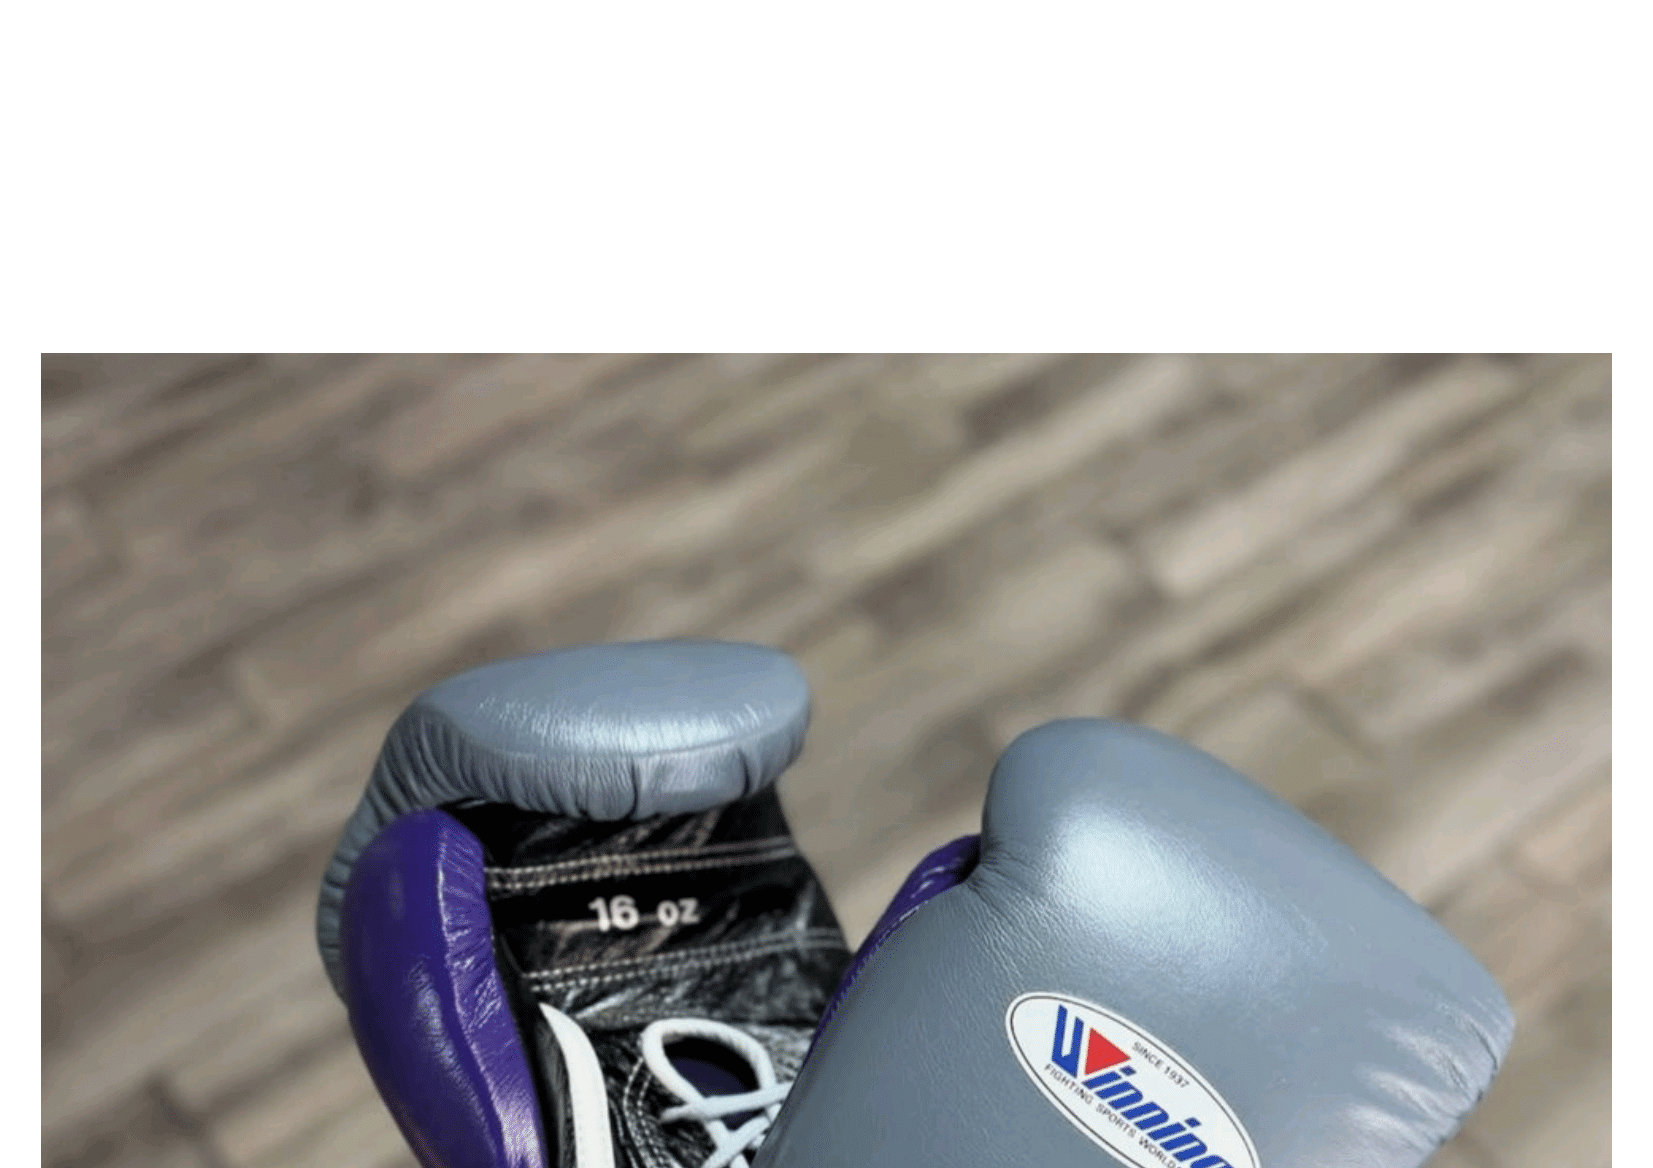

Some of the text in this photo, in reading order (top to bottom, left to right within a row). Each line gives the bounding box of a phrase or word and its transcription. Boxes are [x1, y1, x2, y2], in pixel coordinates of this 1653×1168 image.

[588, 894, 700, 932] 16 oz
[1131, 1041, 1190, 1089] SINCE 1937
[1044, 1063, 1094, 1105] FIGHTING
[1095, 1102, 1136, 1139] SPORTS
